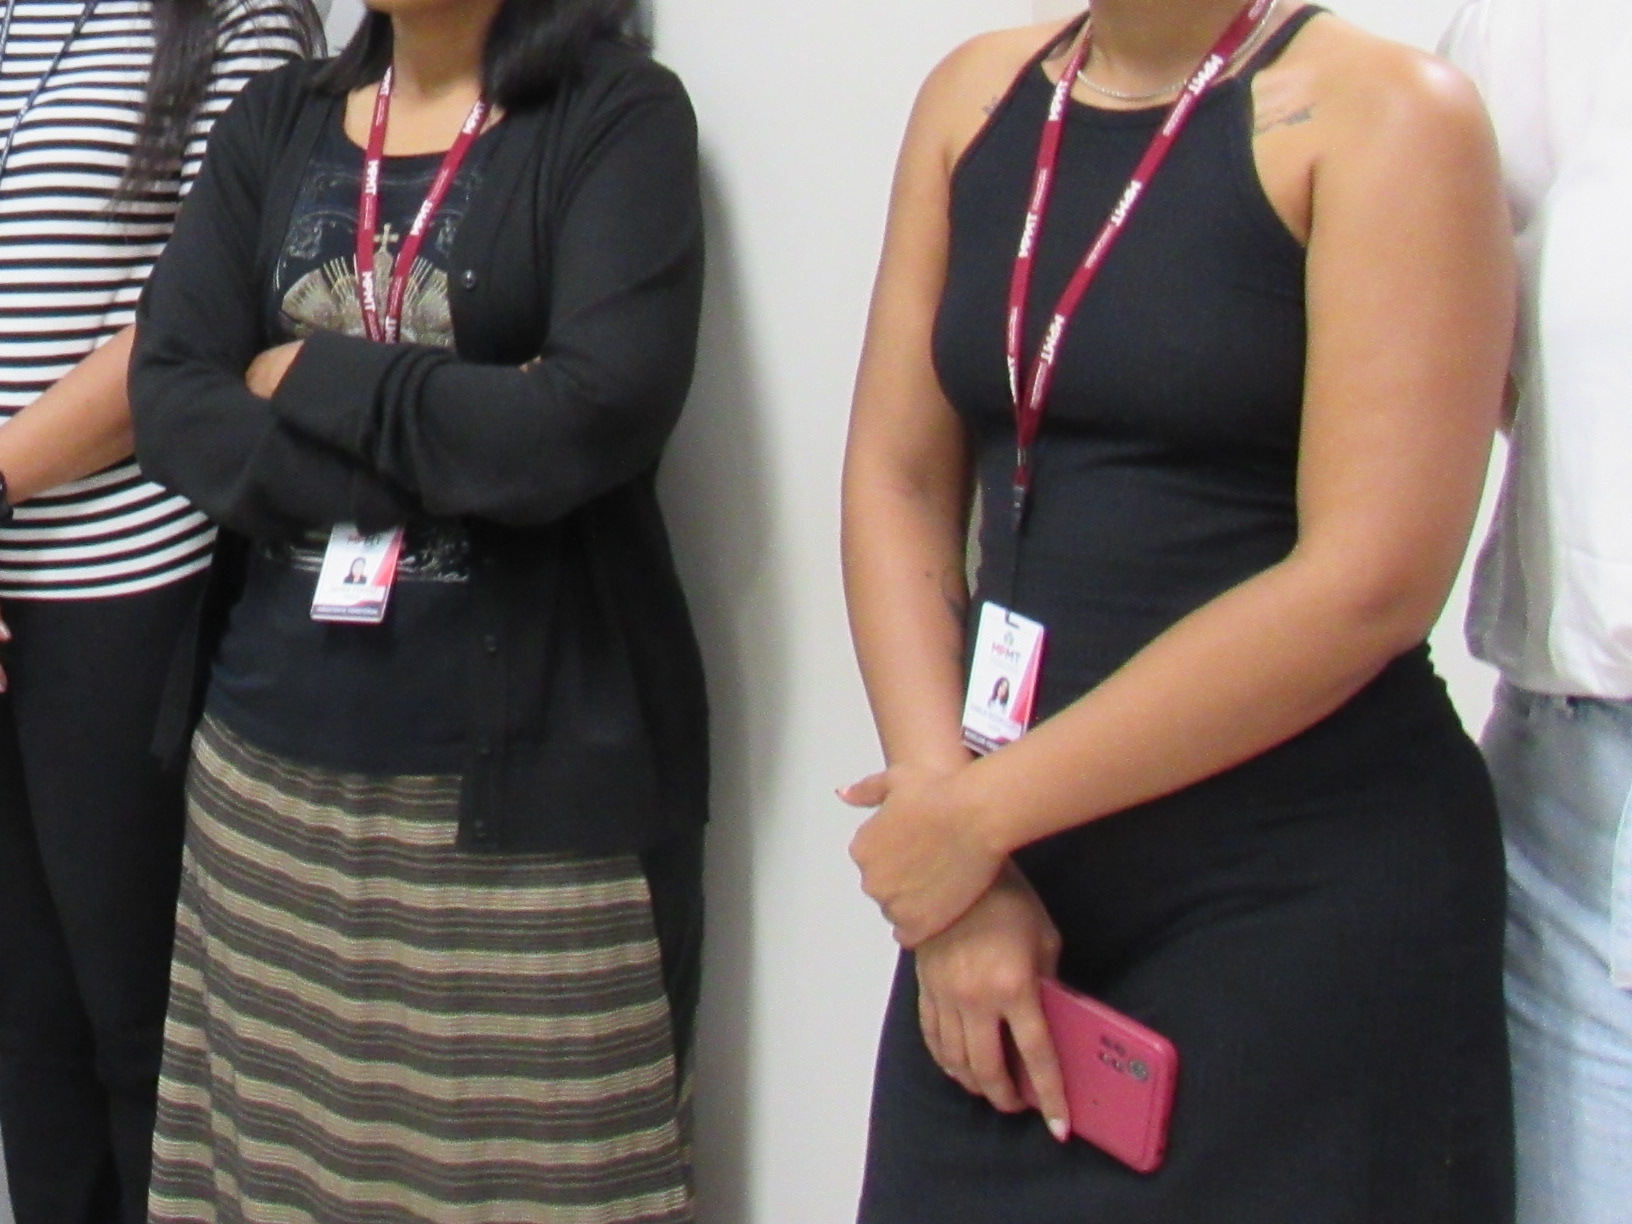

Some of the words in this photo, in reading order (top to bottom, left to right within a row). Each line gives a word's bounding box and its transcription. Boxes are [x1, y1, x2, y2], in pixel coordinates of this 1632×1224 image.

[1187, 53, 1224, 95] MPMT
[365, 159, 380, 195] MPMT
[409, 198, 434, 236] MPMT
[1110, 179, 1143, 227] MPMT
[361, 270, 376, 312] MPMT
[1040, 313, 1065, 365] MPMT
[991, 642, 1020, 663] MPMT
